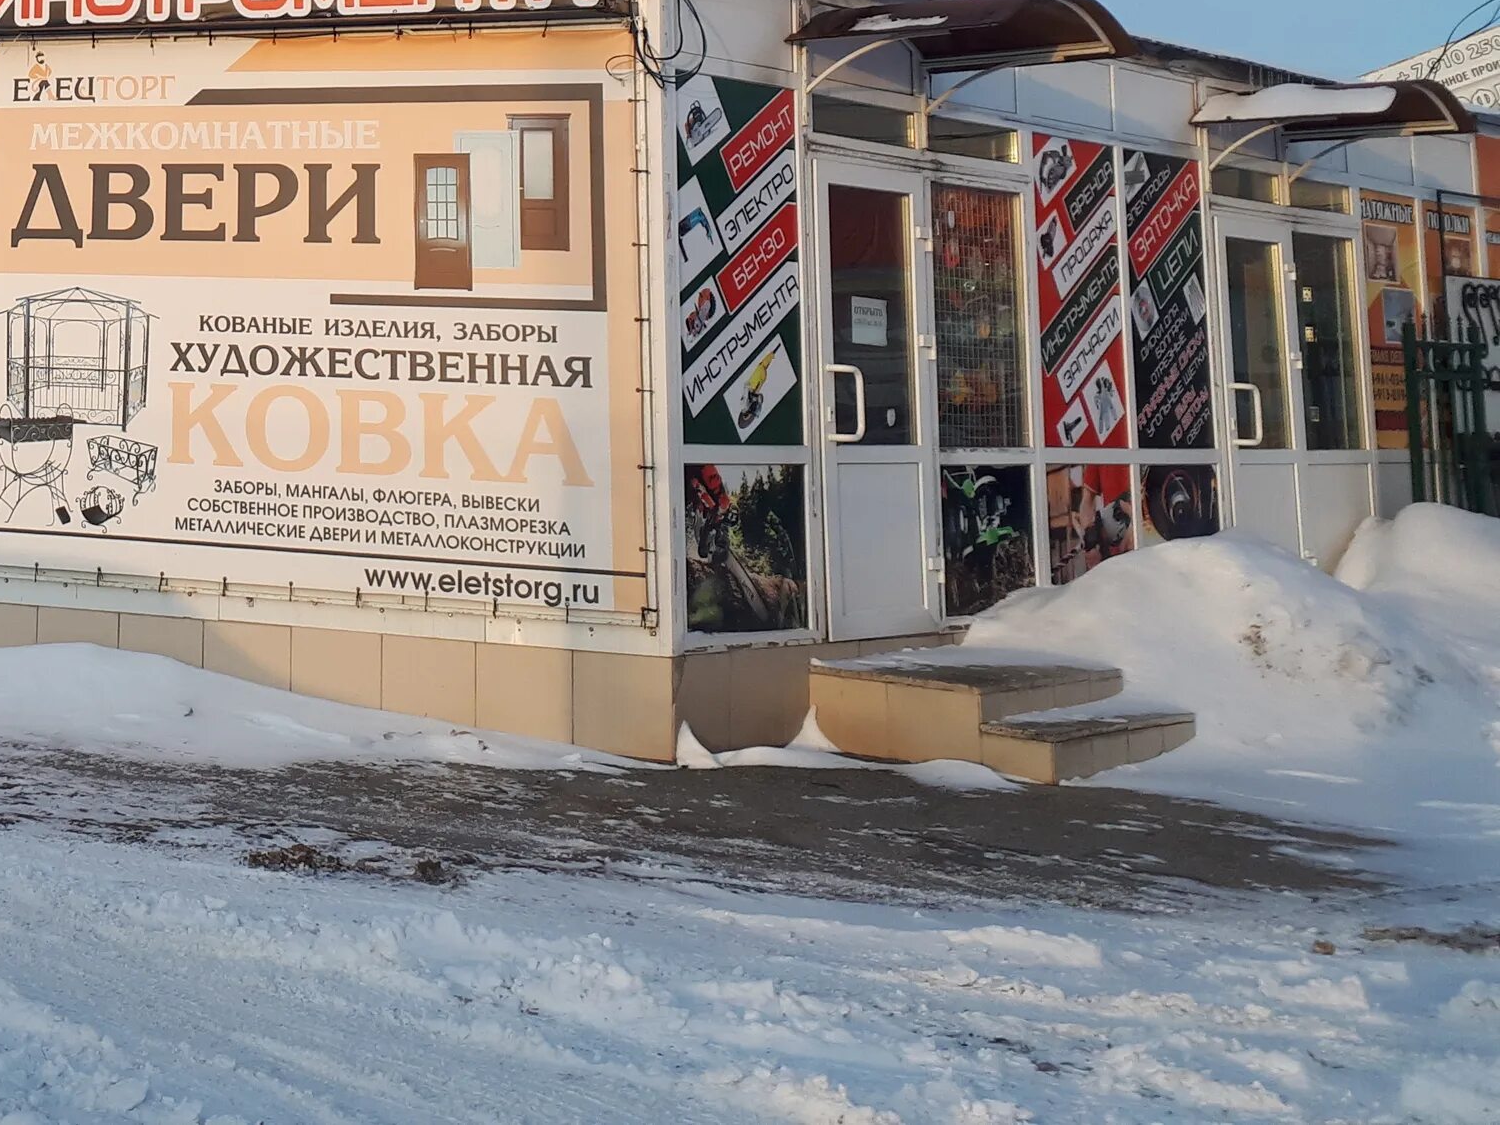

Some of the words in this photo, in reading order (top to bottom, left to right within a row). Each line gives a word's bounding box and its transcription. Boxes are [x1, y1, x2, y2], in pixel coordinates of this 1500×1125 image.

[29, 119, 381, 152] МЕЖКОМНАТНЫЕ
[729, 104, 793, 178] РЕМОНТ
[10, 162, 382, 249] ДВЕРИ
[727, 162, 794, 242] ЭЛЕКТРО
[1069, 161, 1114, 221] АРЕНДА
[1127, 164, 1172, 227] ЭЛЕКТРОДЫ
[1134, 173, 1198, 262] ЗАТОЧКА
[1427, 211, 1469, 233] ПООЛКИ
[732, 226, 786, 291] БЕНЗО
[1060, 209, 1114, 283] ПРОДАЖА
[1157, 227, 1199, 290] ЦЕПИ
[198, 314, 313, 336] КОВАНЫЕ
[324, 318, 442, 343] ИЗДЕЛИЯ,
[452, 321, 558, 344] ЗАБОРЫ
[686, 274, 800, 403] ИНСТРУМЕНТА
[1041, 255, 1119, 363] ИНСТРУМЕНТА
[169, 340, 594, 389] ХУДОЖЕСТВЕННАЯ
[1062, 307, 1120, 388] ЗАПЧАСТИ
[166, 381, 595, 488] КОВКА
[187, 497, 299, 518] СОБСТВЕННОЕ
[302, 504, 440, 529] ПРОИЗВОДСТВО,
[444, 514, 571, 536] ПЛАЗМОРЕЗКА
[213, 479, 281, 499] ЗАБОРЫ,
[286, 483, 369, 505] МАНГАЛЫ,
[373, 487, 457, 509] ФЛЮГЕРА,
[461, 494, 540, 513] ВЫВЕСКИ
[174, 516, 306, 539] МЕТАЛЛИЧЕСКИЕ
[309, 526, 361, 543] ДВЕРИ
[365, 529, 376, 544] И
[381, 531, 586, 559] МЕТАЛЛОКОНСТРУКЦИИ
[364, 568, 600, 607] www.eletstorg.ru
